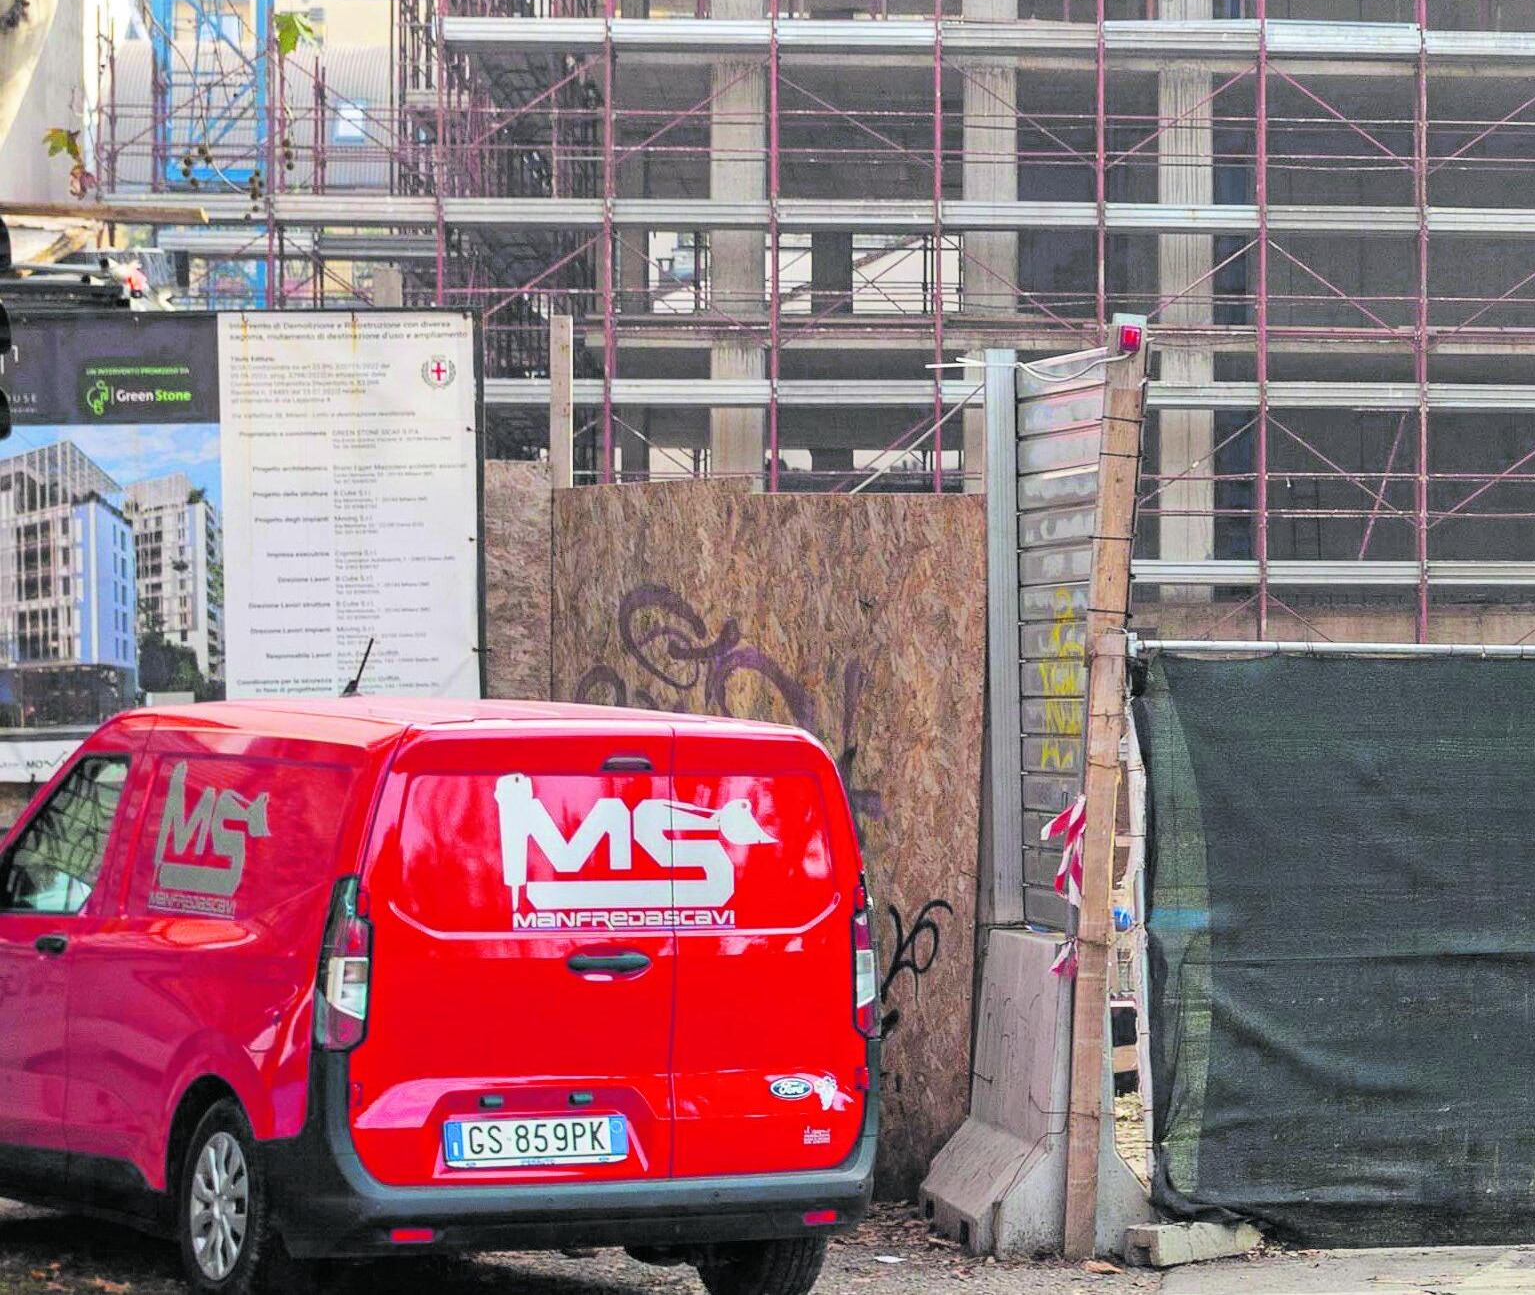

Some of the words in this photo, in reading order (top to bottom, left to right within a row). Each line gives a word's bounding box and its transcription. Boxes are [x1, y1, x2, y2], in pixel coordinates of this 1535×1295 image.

[116, 389, 153, 403] Green
[155, 389, 192, 402] Stone
[494, 773, 779, 909] MS
[469, 1125, 503, 1154] GS
[515, 1121, 605, 1153] 859PK
